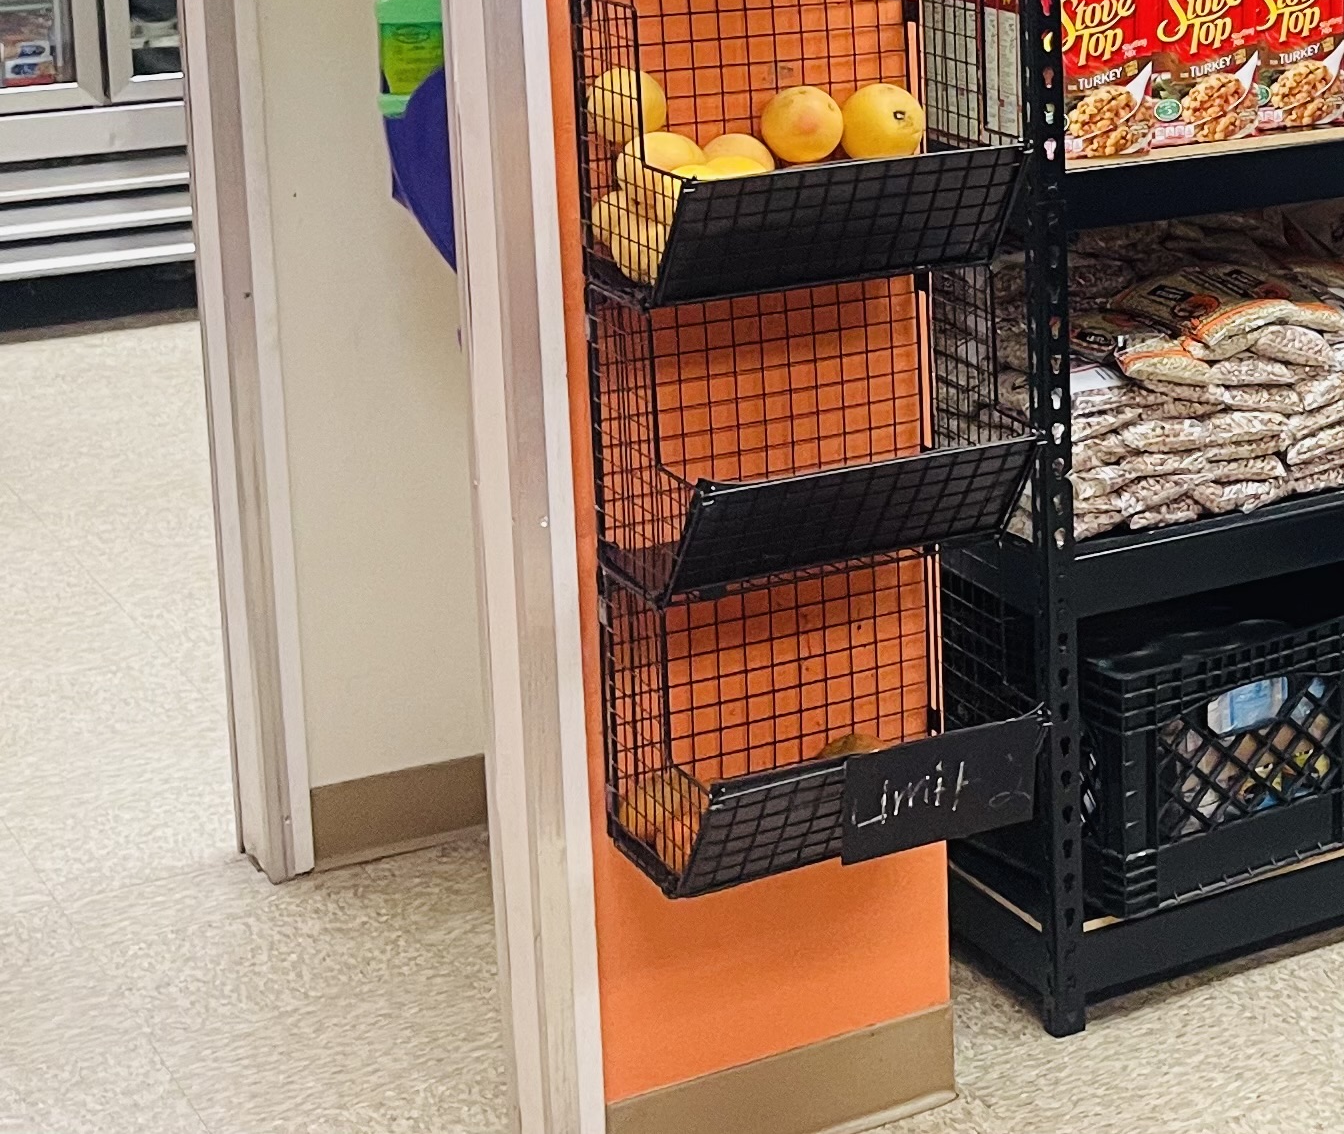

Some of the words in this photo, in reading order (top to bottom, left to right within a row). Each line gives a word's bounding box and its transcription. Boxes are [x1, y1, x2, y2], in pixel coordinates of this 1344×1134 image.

[1189, 15, 1232, 55] Top
[1278, 5, 1321, 43] Top
[1078, 25, 1123, 67] Top
[1278, 42, 1321, 65] TURKEY
[1078, 66, 1123, 92] TURKEY
[1189, 54, 1232, 79] TURKEY
[850, 759, 972, 828] Limit
